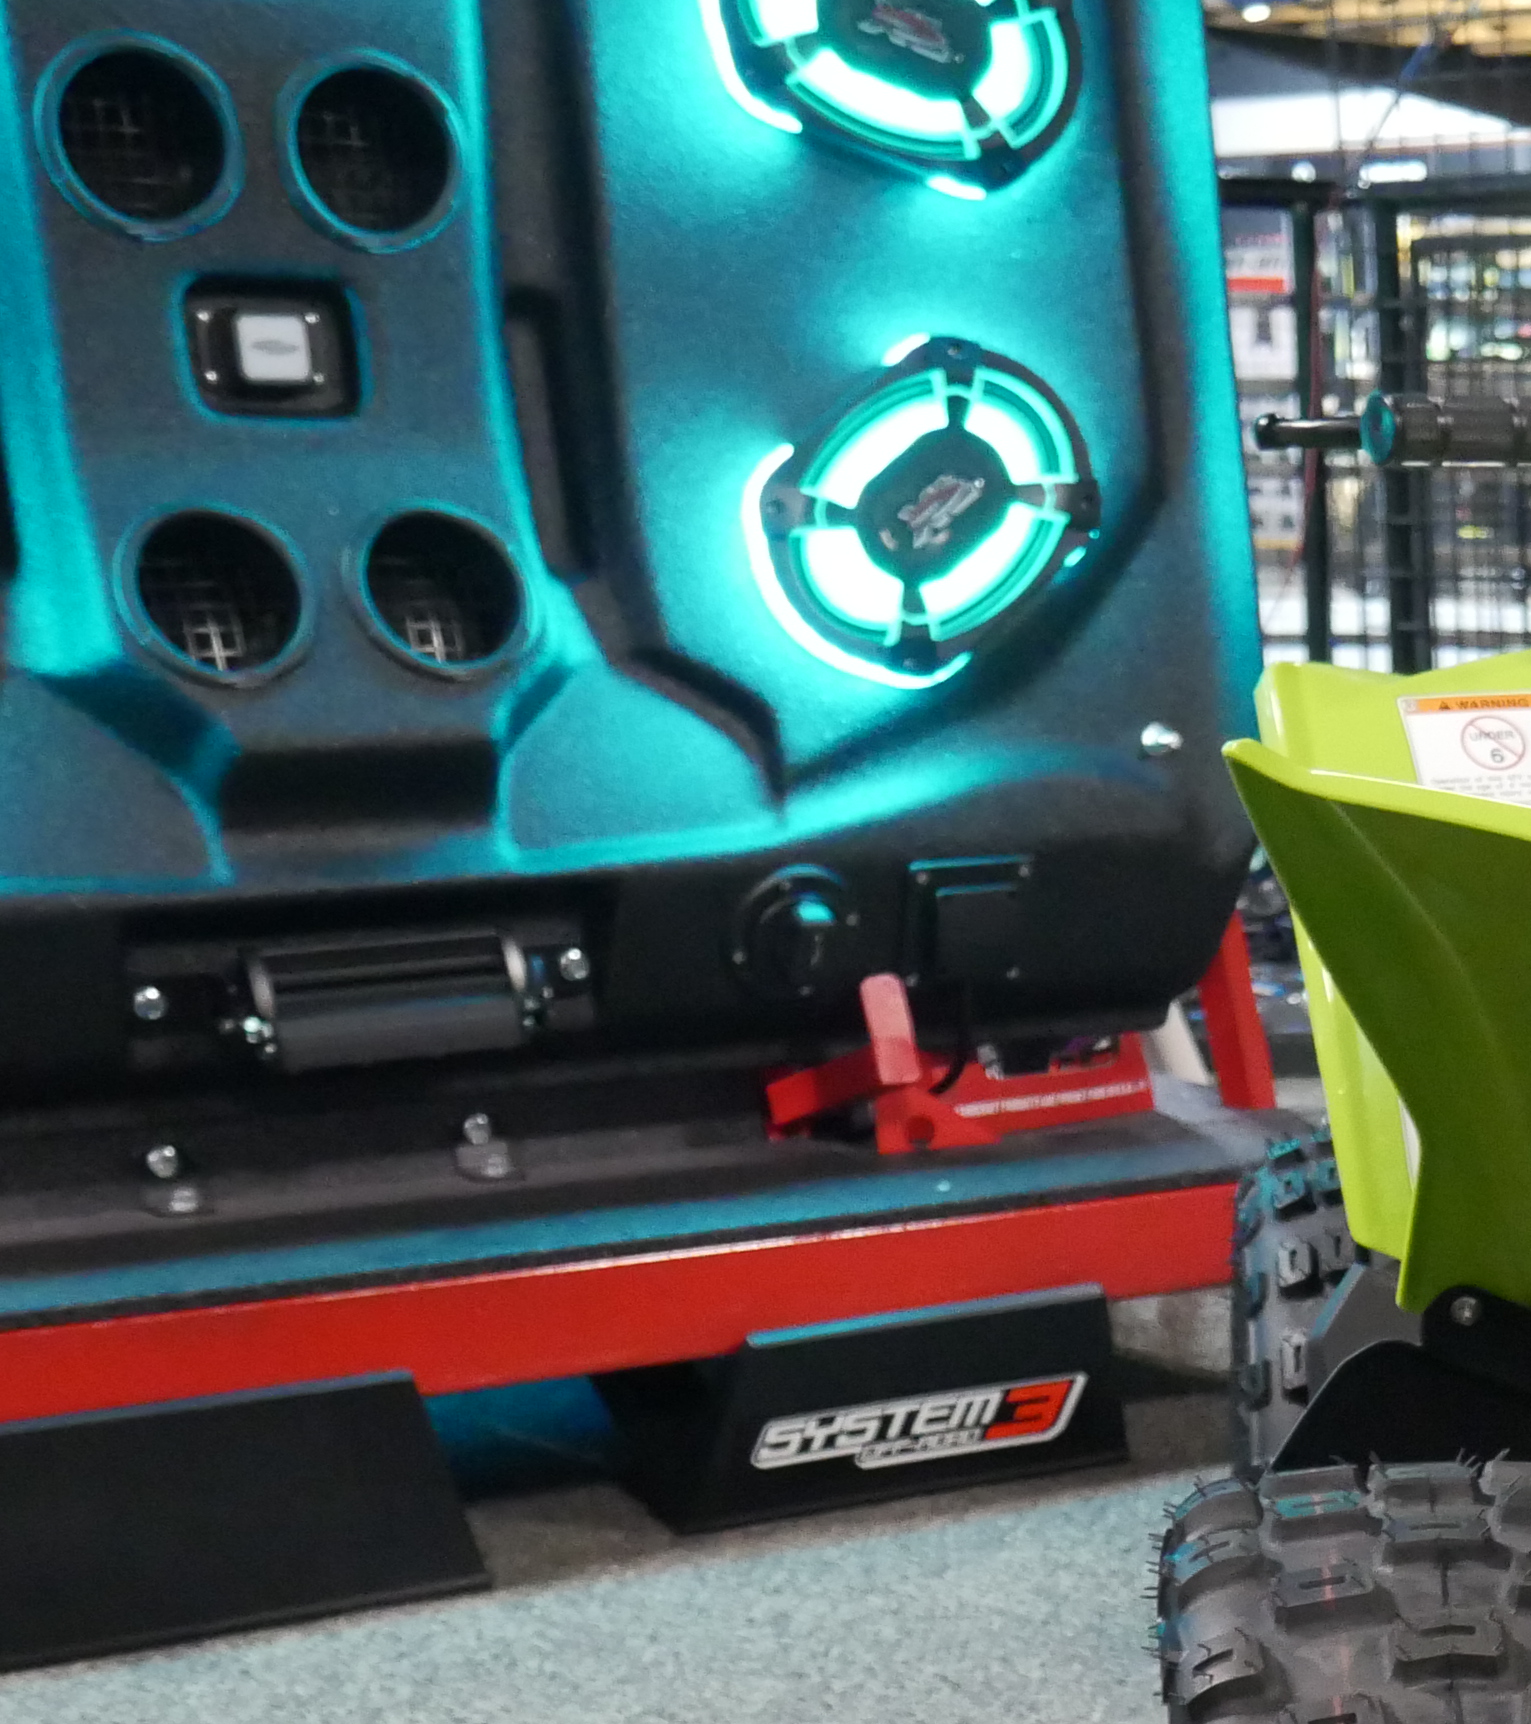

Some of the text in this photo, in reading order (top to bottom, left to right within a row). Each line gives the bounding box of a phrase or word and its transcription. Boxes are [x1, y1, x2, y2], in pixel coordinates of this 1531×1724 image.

[1458, 698, 1530, 711] WARNING
[1469, 730, 1514, 742] UNDER
[1490, 748, 1504, 763] 6
[761, 1379, 1074, 1456] SYSTEM 3
